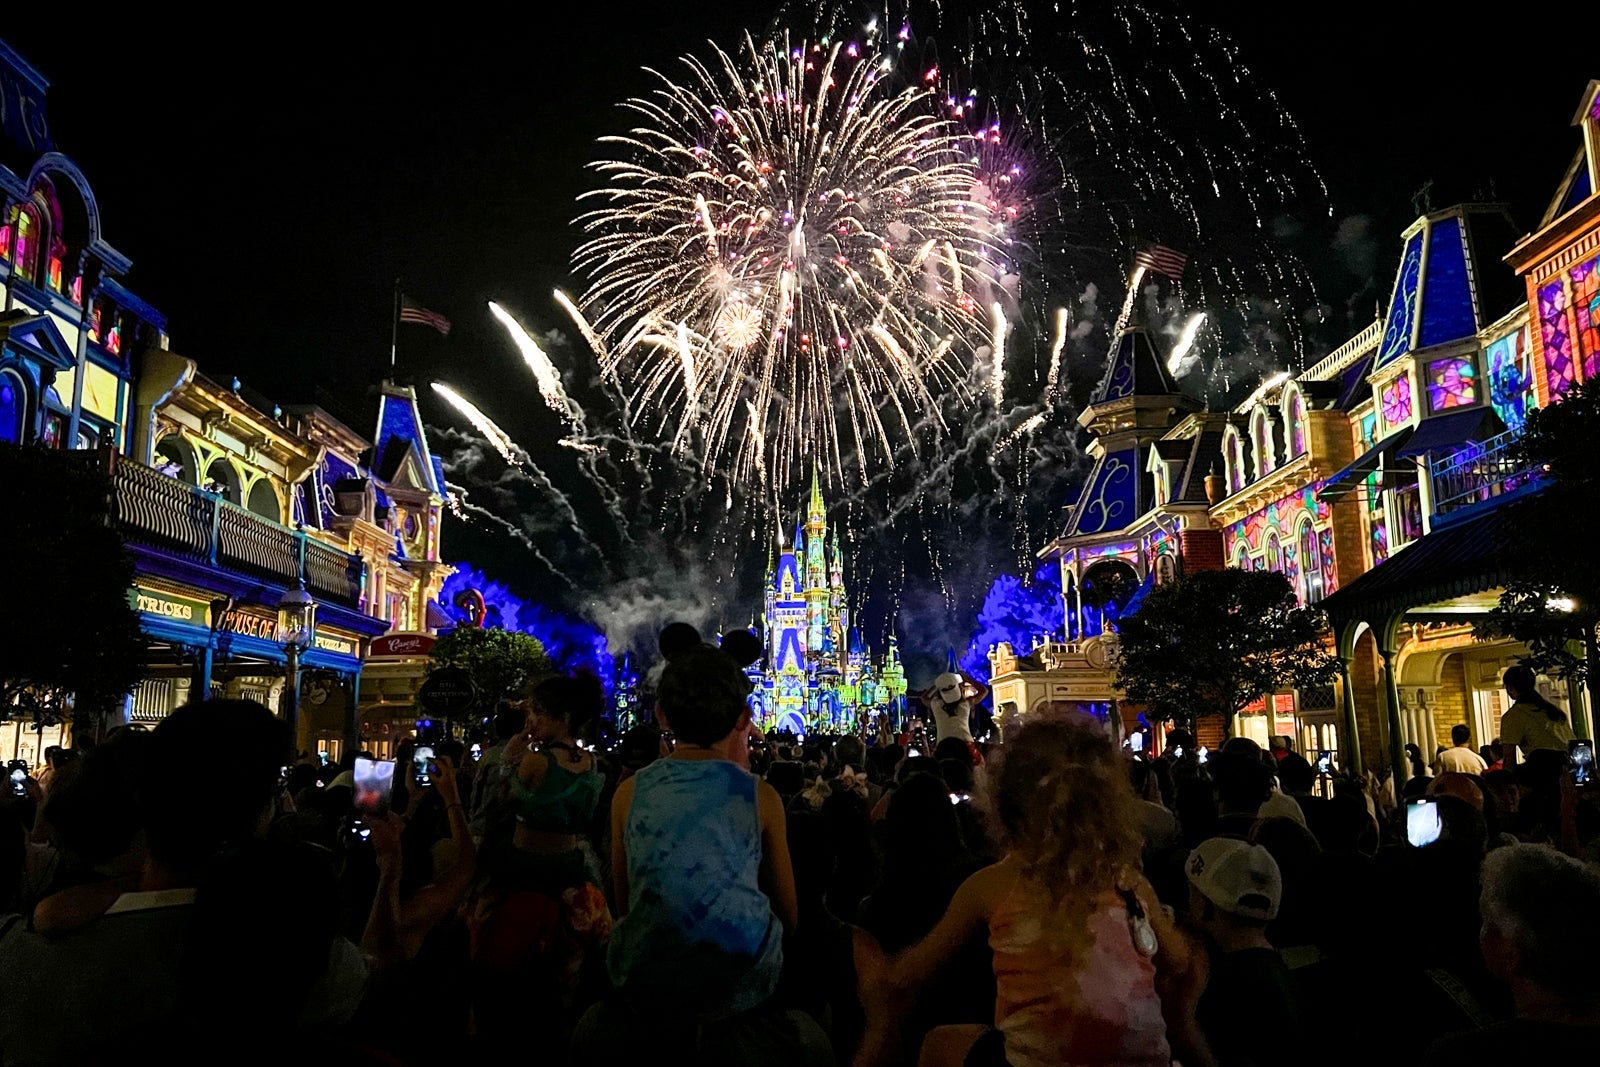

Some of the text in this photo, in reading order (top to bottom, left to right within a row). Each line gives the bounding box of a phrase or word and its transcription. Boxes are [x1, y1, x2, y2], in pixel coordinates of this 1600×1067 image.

[137, 594, 192, 619] TRICKS
[222, 611, 259, 636] HOUSE
[259, 619, 273, 640] OF
